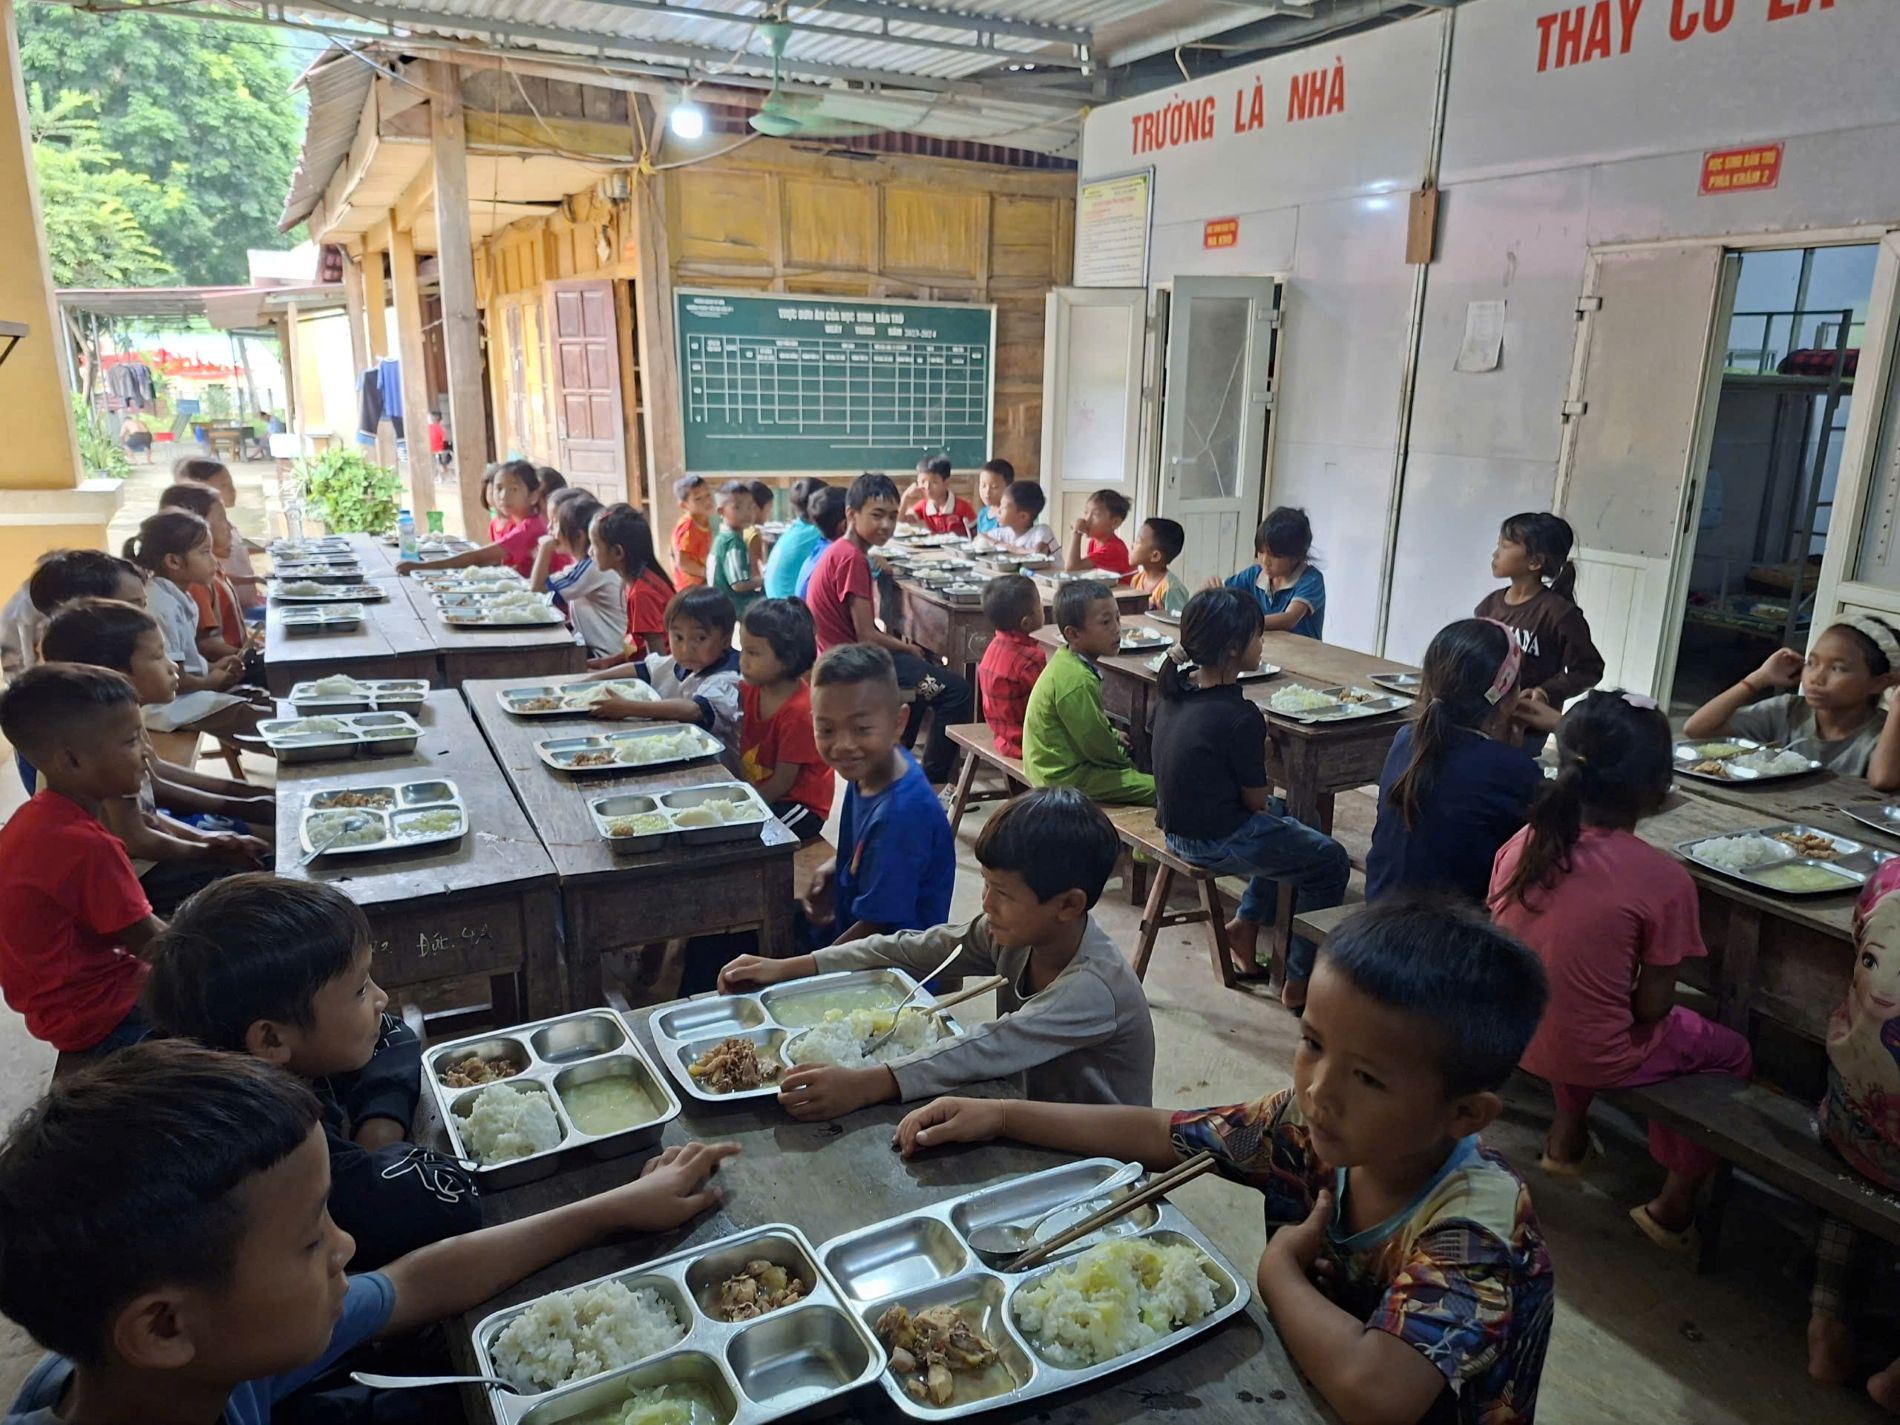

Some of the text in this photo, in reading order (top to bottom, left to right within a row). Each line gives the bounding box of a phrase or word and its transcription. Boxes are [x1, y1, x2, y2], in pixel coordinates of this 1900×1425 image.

[1132, 56, 1346, 156] TRƯỜNG LÀ NHÀ
